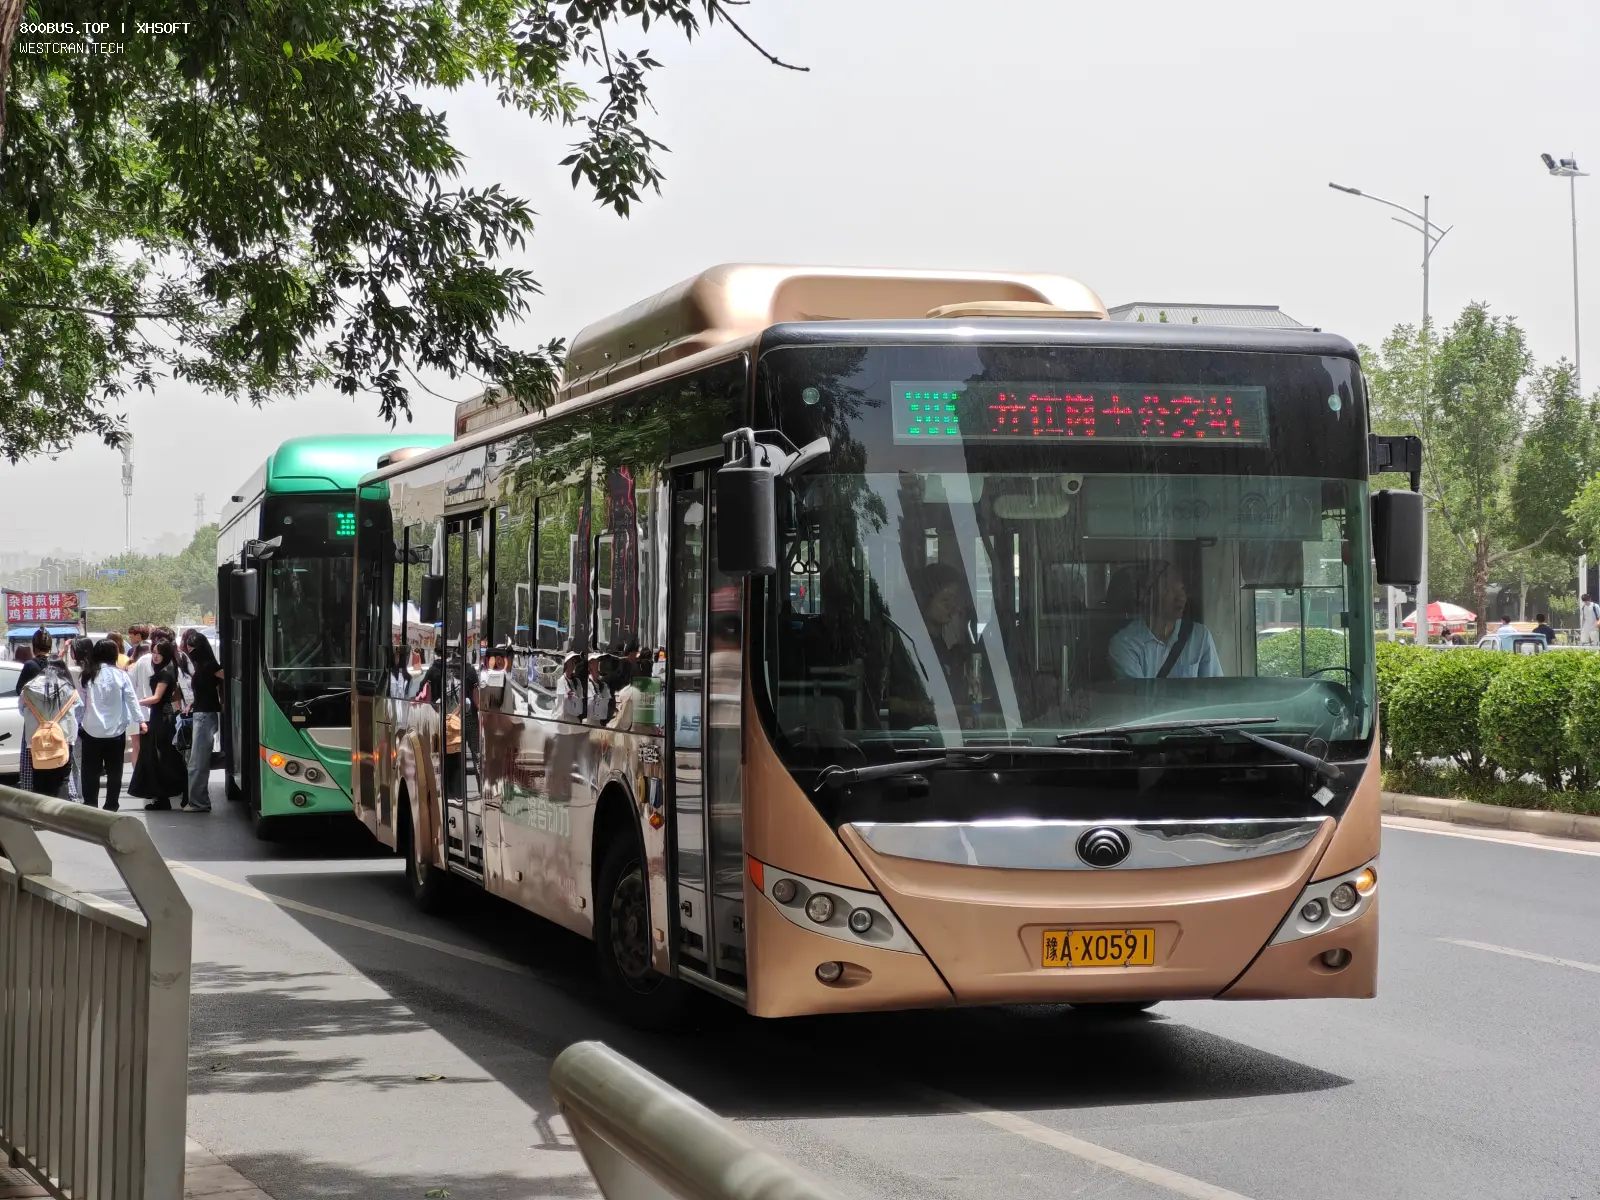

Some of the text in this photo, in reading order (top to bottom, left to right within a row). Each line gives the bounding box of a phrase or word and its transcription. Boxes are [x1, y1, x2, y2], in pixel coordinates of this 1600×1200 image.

[8, 594, 61, 607] 杂粮煎饼
[8, 608, 61, 620] 鸡蛋灌饼
[528, 797, 571, 838] 混合动力
